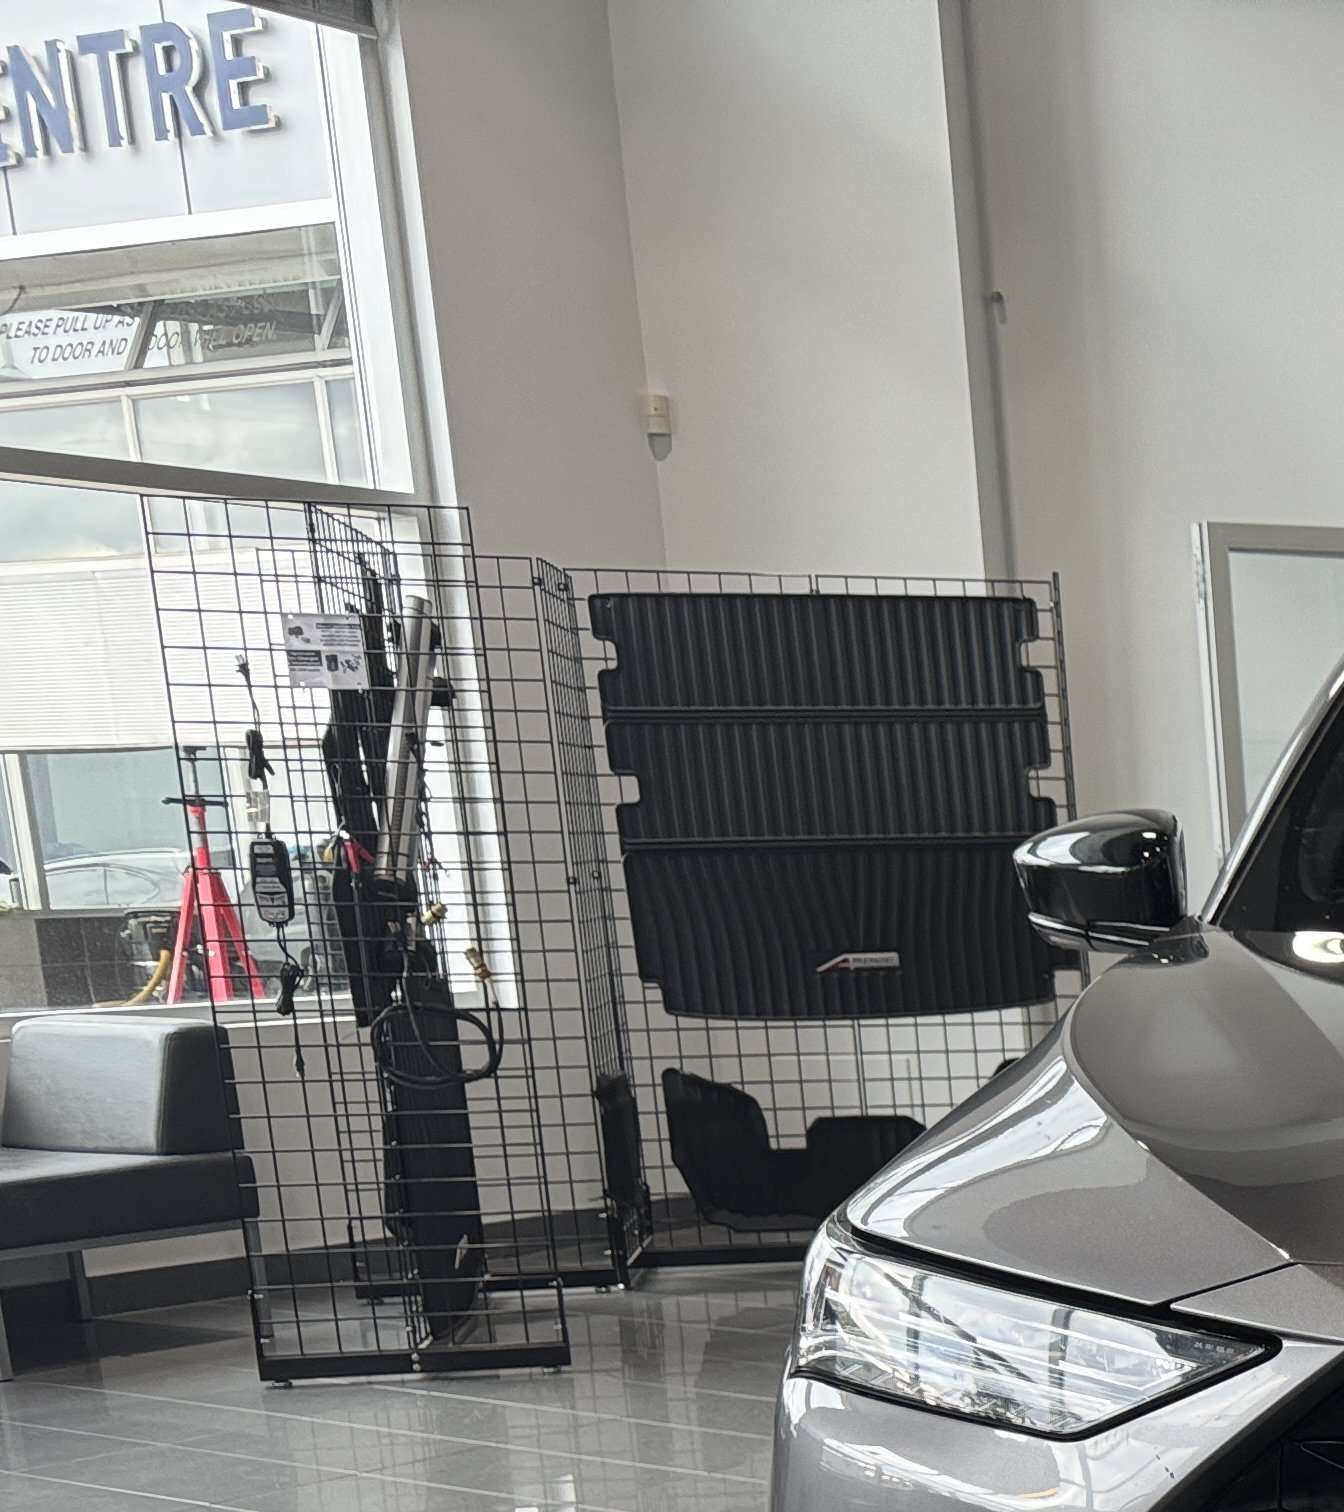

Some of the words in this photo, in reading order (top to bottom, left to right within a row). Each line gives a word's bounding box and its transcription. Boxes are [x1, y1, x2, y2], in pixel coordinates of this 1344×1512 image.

[0, 7, 281, 168] NTRE
[0, 318, 53, 339] PLEASE
[54, 314, 88, 334] PULL
[30, 345, 50, 364] TO
[51, 341, 95, 362] DOOR
[95, 338, 128, 358] AND
